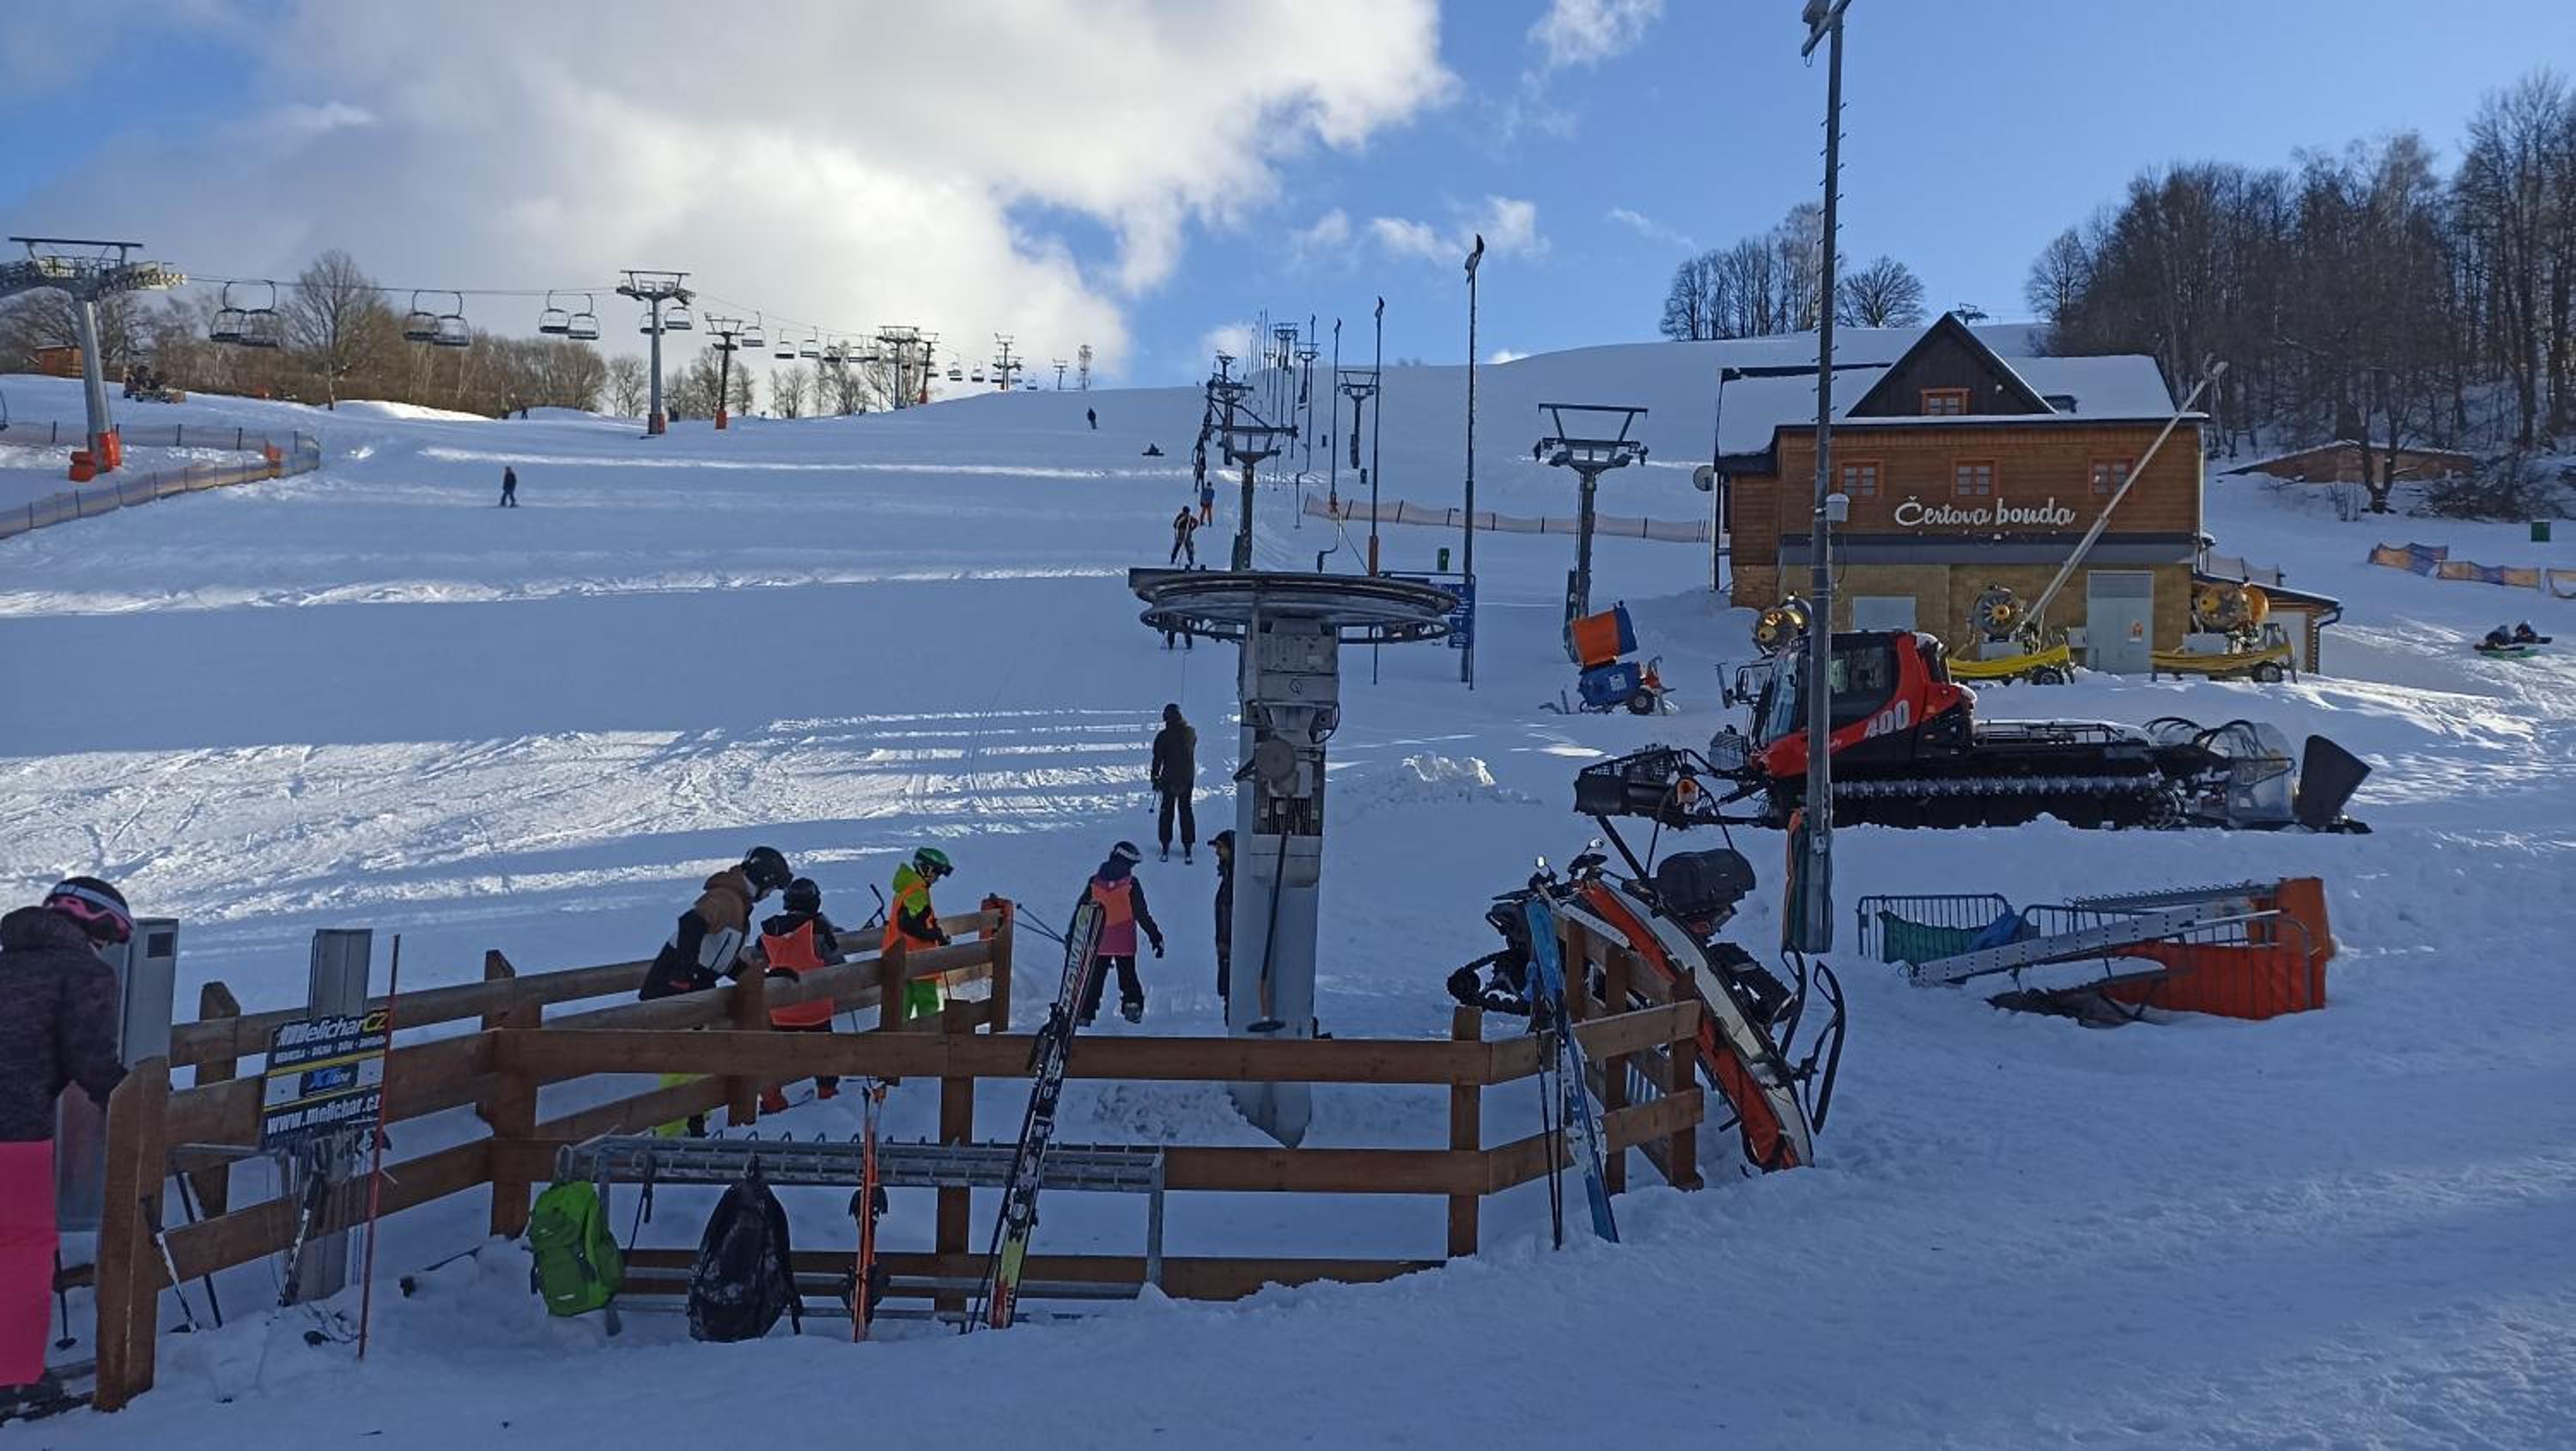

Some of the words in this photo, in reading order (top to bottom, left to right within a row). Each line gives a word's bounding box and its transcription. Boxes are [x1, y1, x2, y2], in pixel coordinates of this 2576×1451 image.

[1894, 495, 1992, 525] Čertova
[1995, 496, 2075, 525] bouda
[1864, 700, 1910, 738] 400
[267, 1094, 380, 1135] www.melichar.cz
